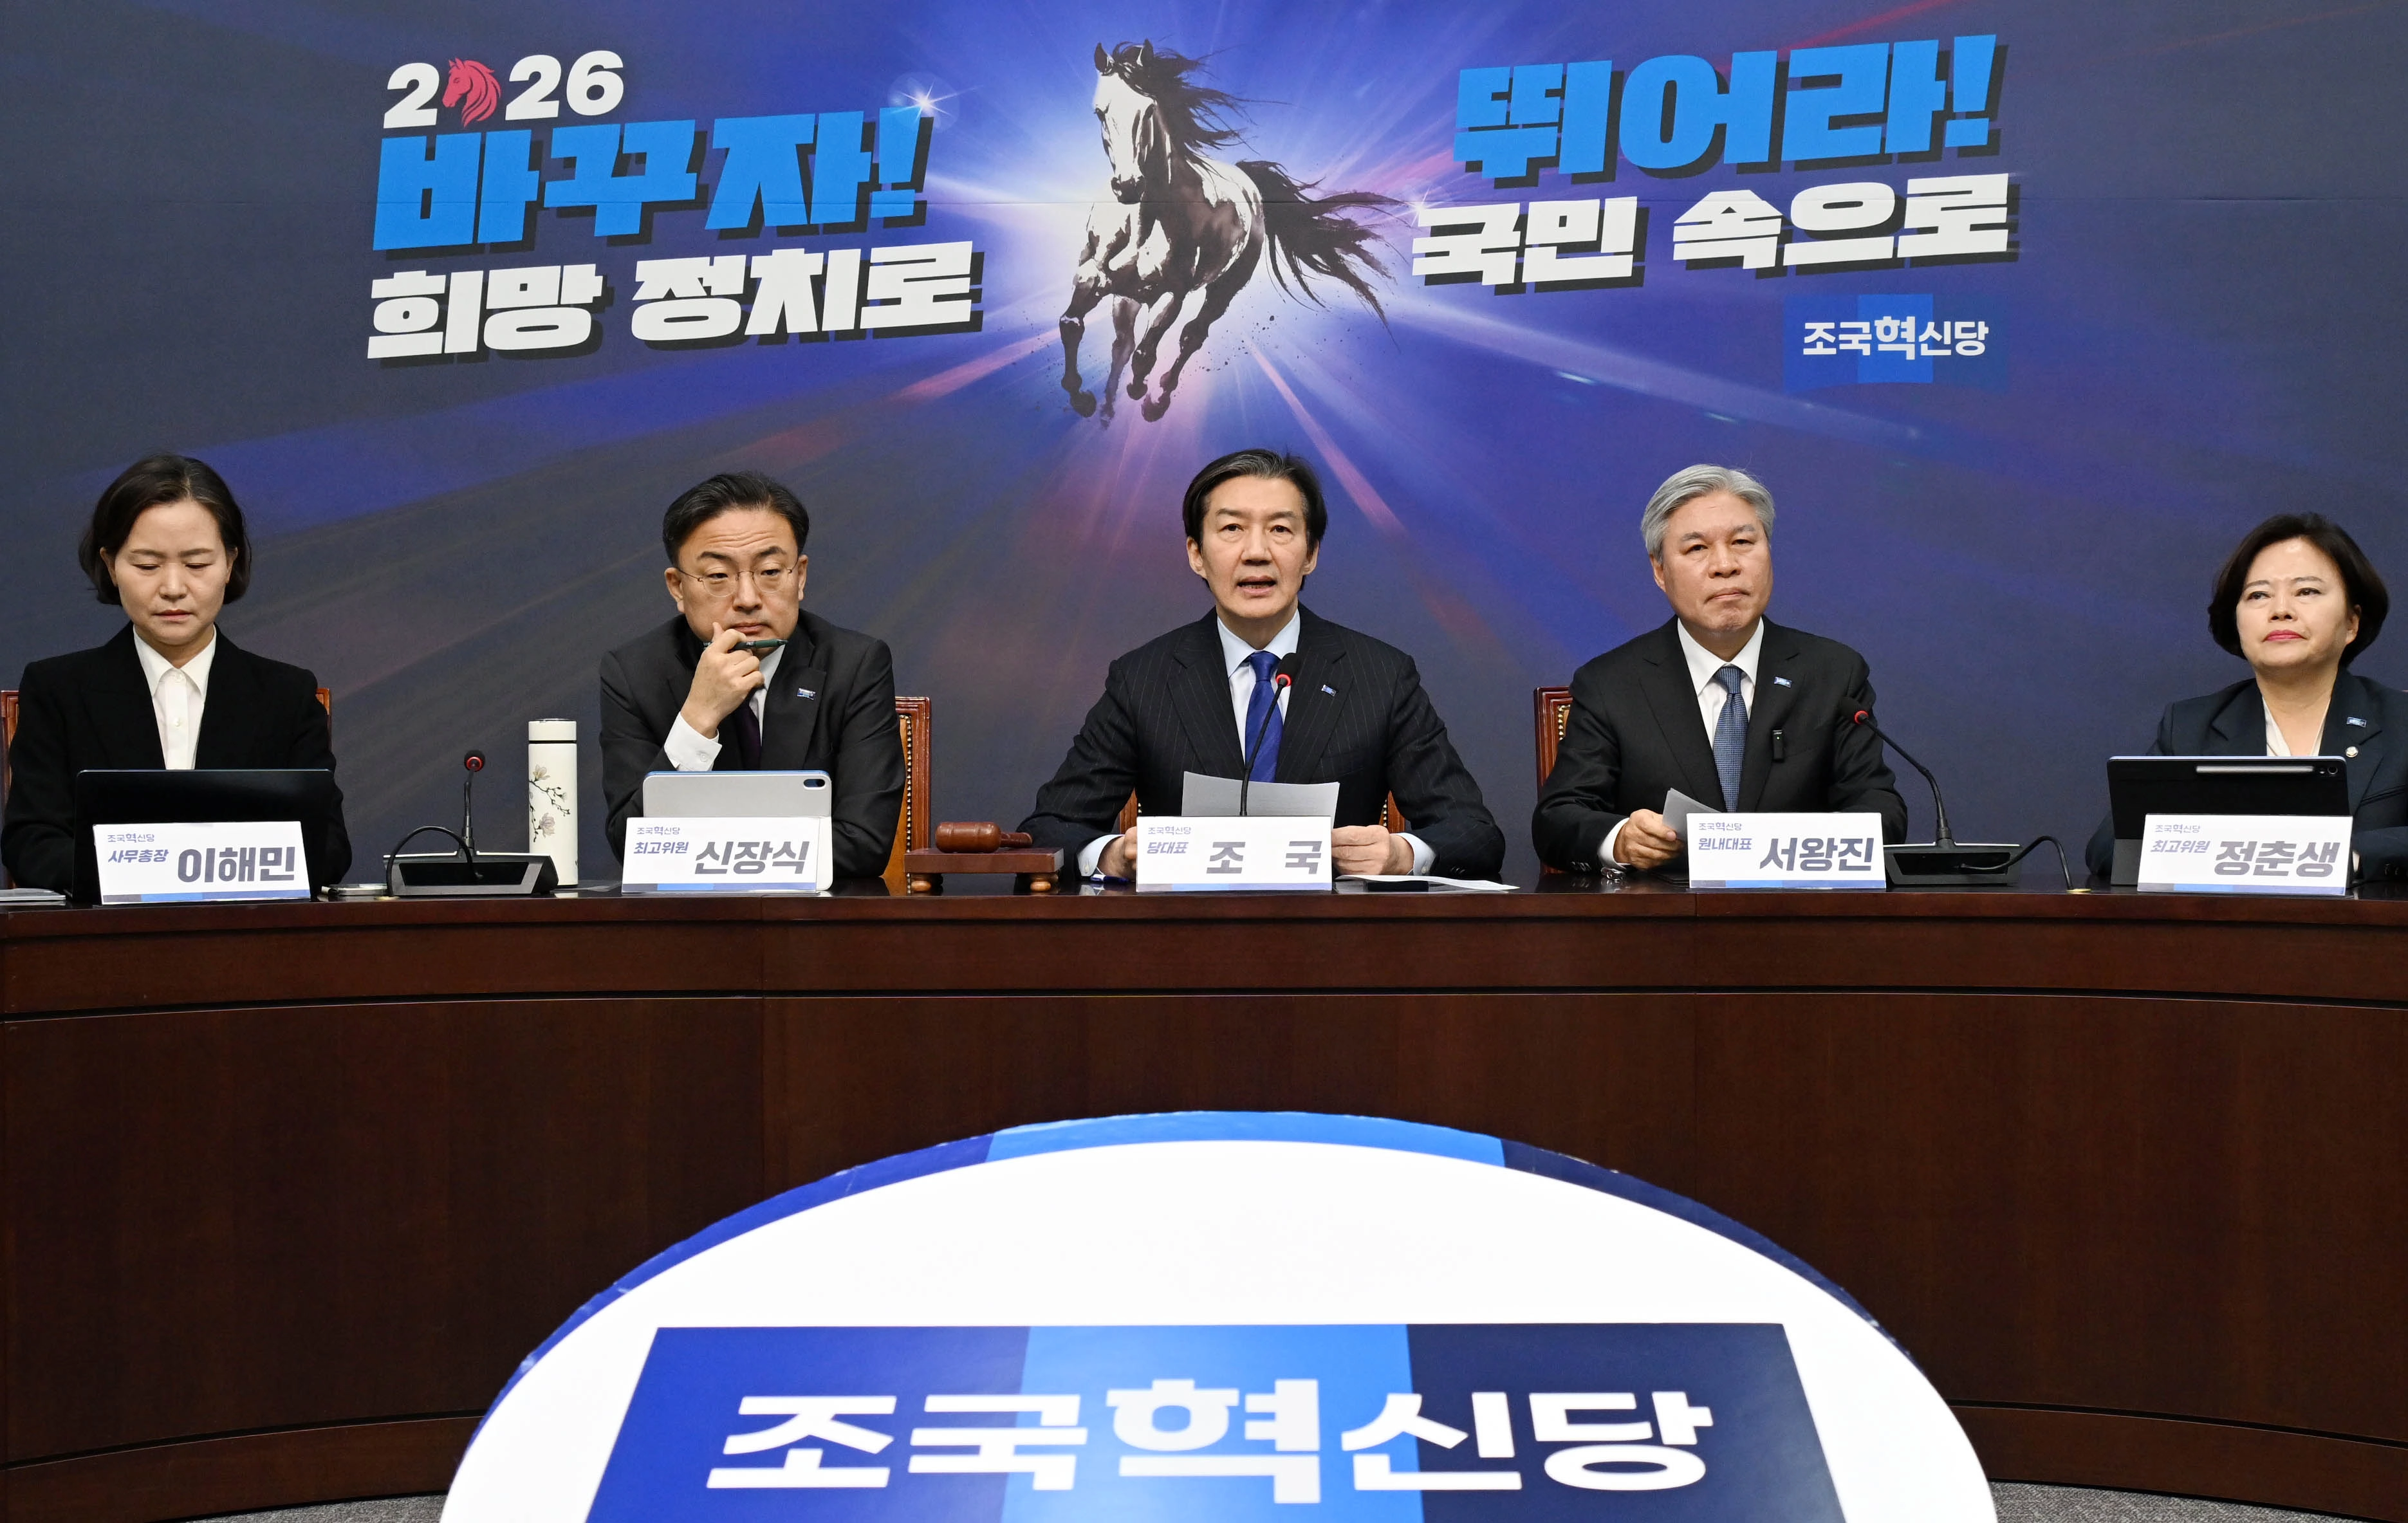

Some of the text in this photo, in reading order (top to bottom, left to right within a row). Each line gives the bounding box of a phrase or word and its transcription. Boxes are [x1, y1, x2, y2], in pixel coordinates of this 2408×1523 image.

[1453, 34, 1997, 179] 뛰어라!
[373, 106, 922, 250] 바꾸자!
[1412, 173, 2009, 285] 국민 속으로
[367, 241, 973, 359] 희망 정치로
[1802, 315, 1989, 360] 조국혁신당
[107, 833, 155, 844] 조국혁신당
[636, 826, 681, 836] 조국혁신당
[1147, 826, 1192, 836] 조국혁신당
[1698, 822, 1743, 831] 조국혁신당
[2154, 824, 2201, 834] 조국혁신당
[107, 846, 295, 883] 사무총장 이해민
[633, 841, 810, 874] 최고위원 신장식
[1147, 841, 1189, 854] 당대표
[1698, 837, 1875, 871] 원내대표 서왕진
[2150, 840, 2340, 878] 최고위원 정춘생
[707, 1379, 1713, 1504] 조국혁신당
